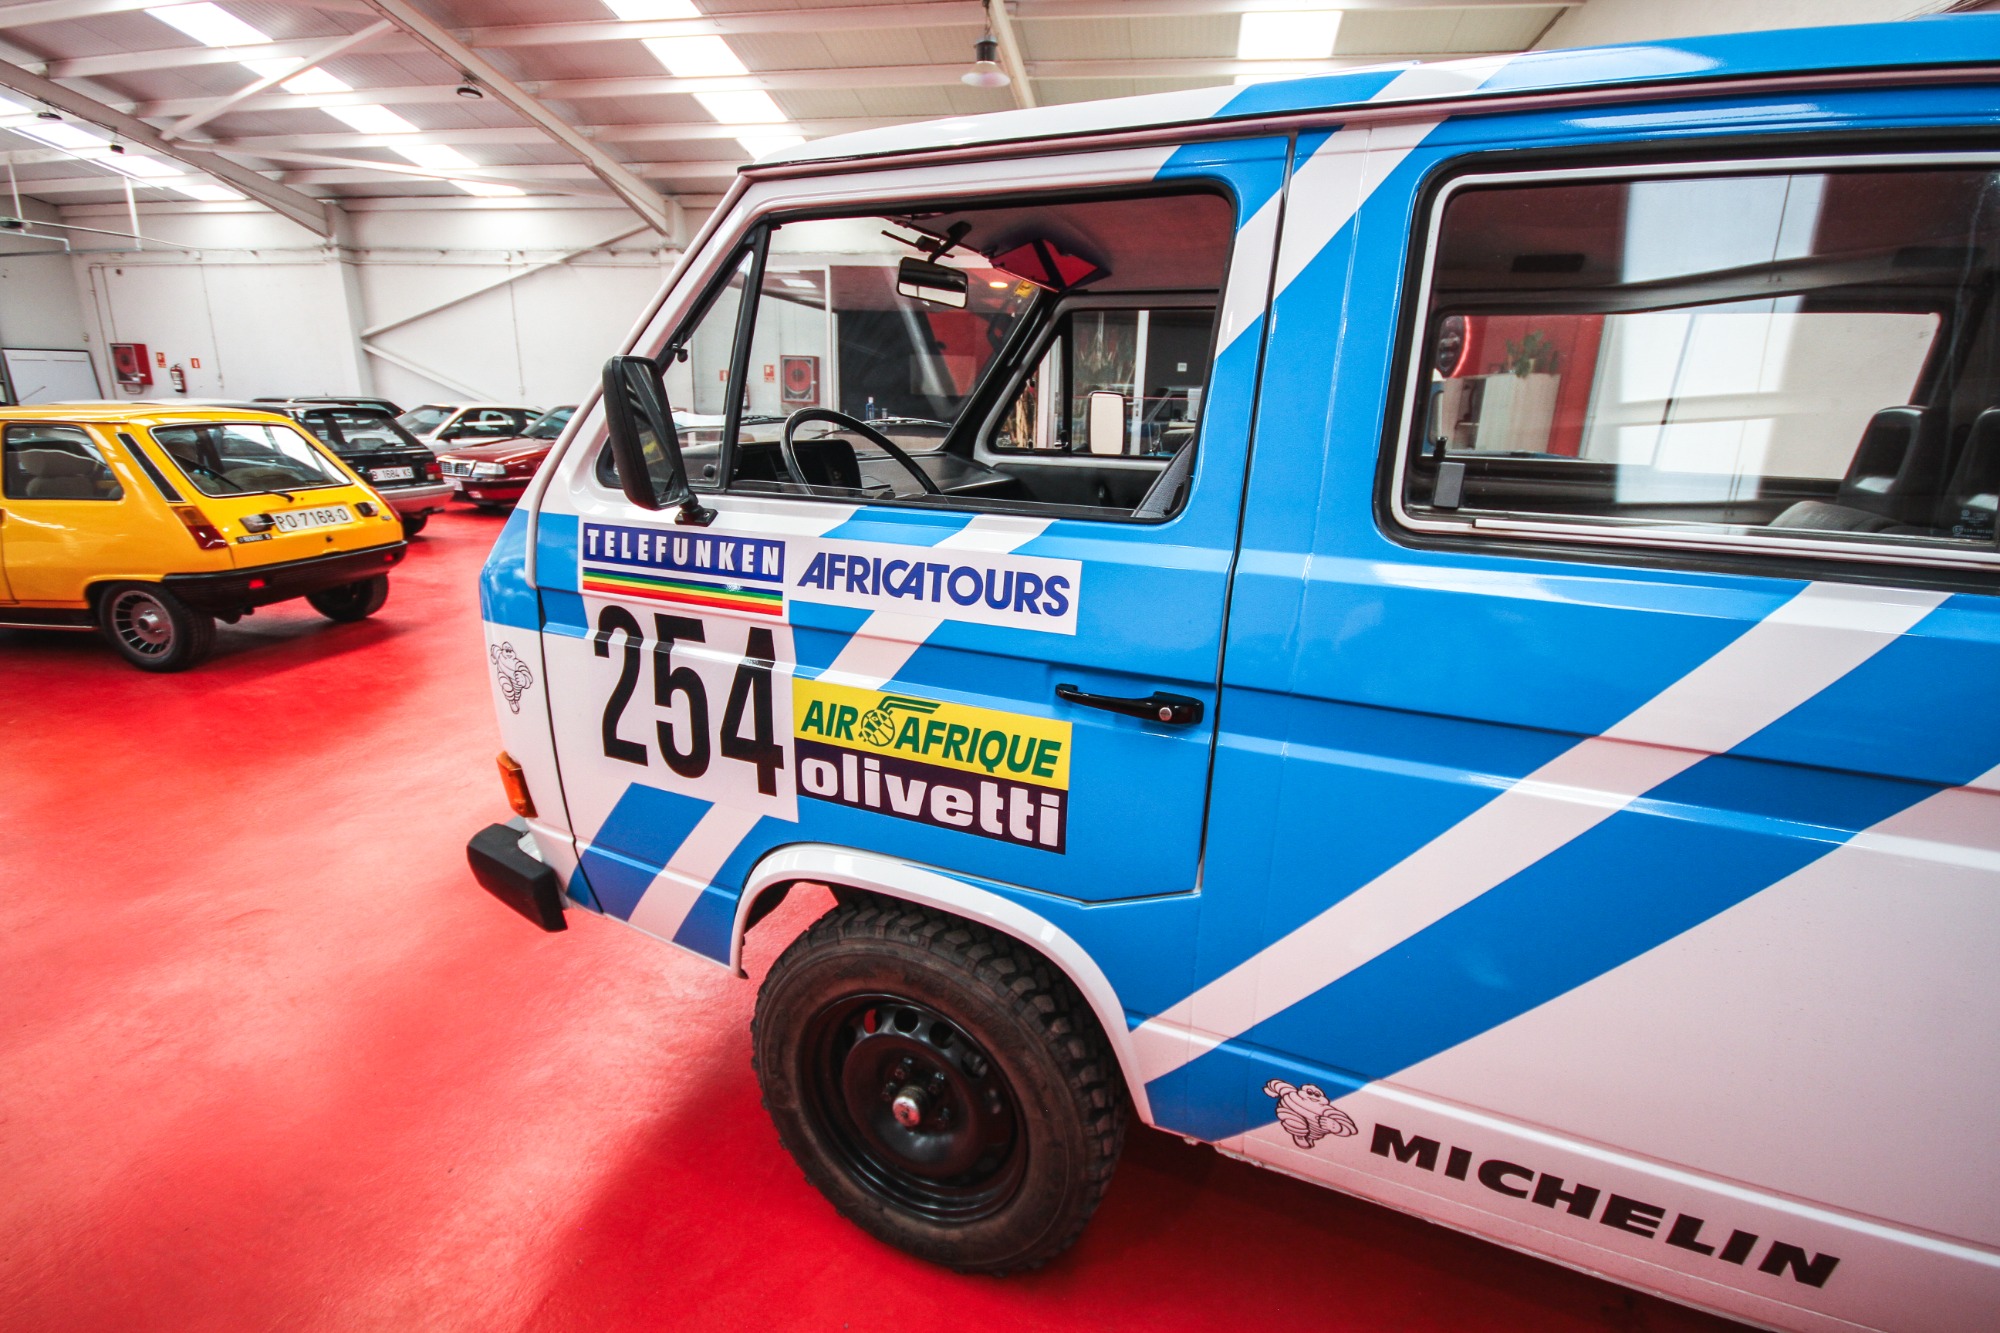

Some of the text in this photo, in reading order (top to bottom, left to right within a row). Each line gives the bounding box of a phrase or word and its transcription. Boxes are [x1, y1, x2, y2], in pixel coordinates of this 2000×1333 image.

[382, 469, 400, 479] 1684
[587, 528, 780, 576] TELEFUNKEN
[797, 552, 1070, 617] AFRICATOURS
[594, 605, 785, 797] 254
[800, 700, 1062, 778] AIR AFRIQUE
[801, 753, 1060, 847] olivetti
[1369, 1122, 1840, 1289] MICHELIN
